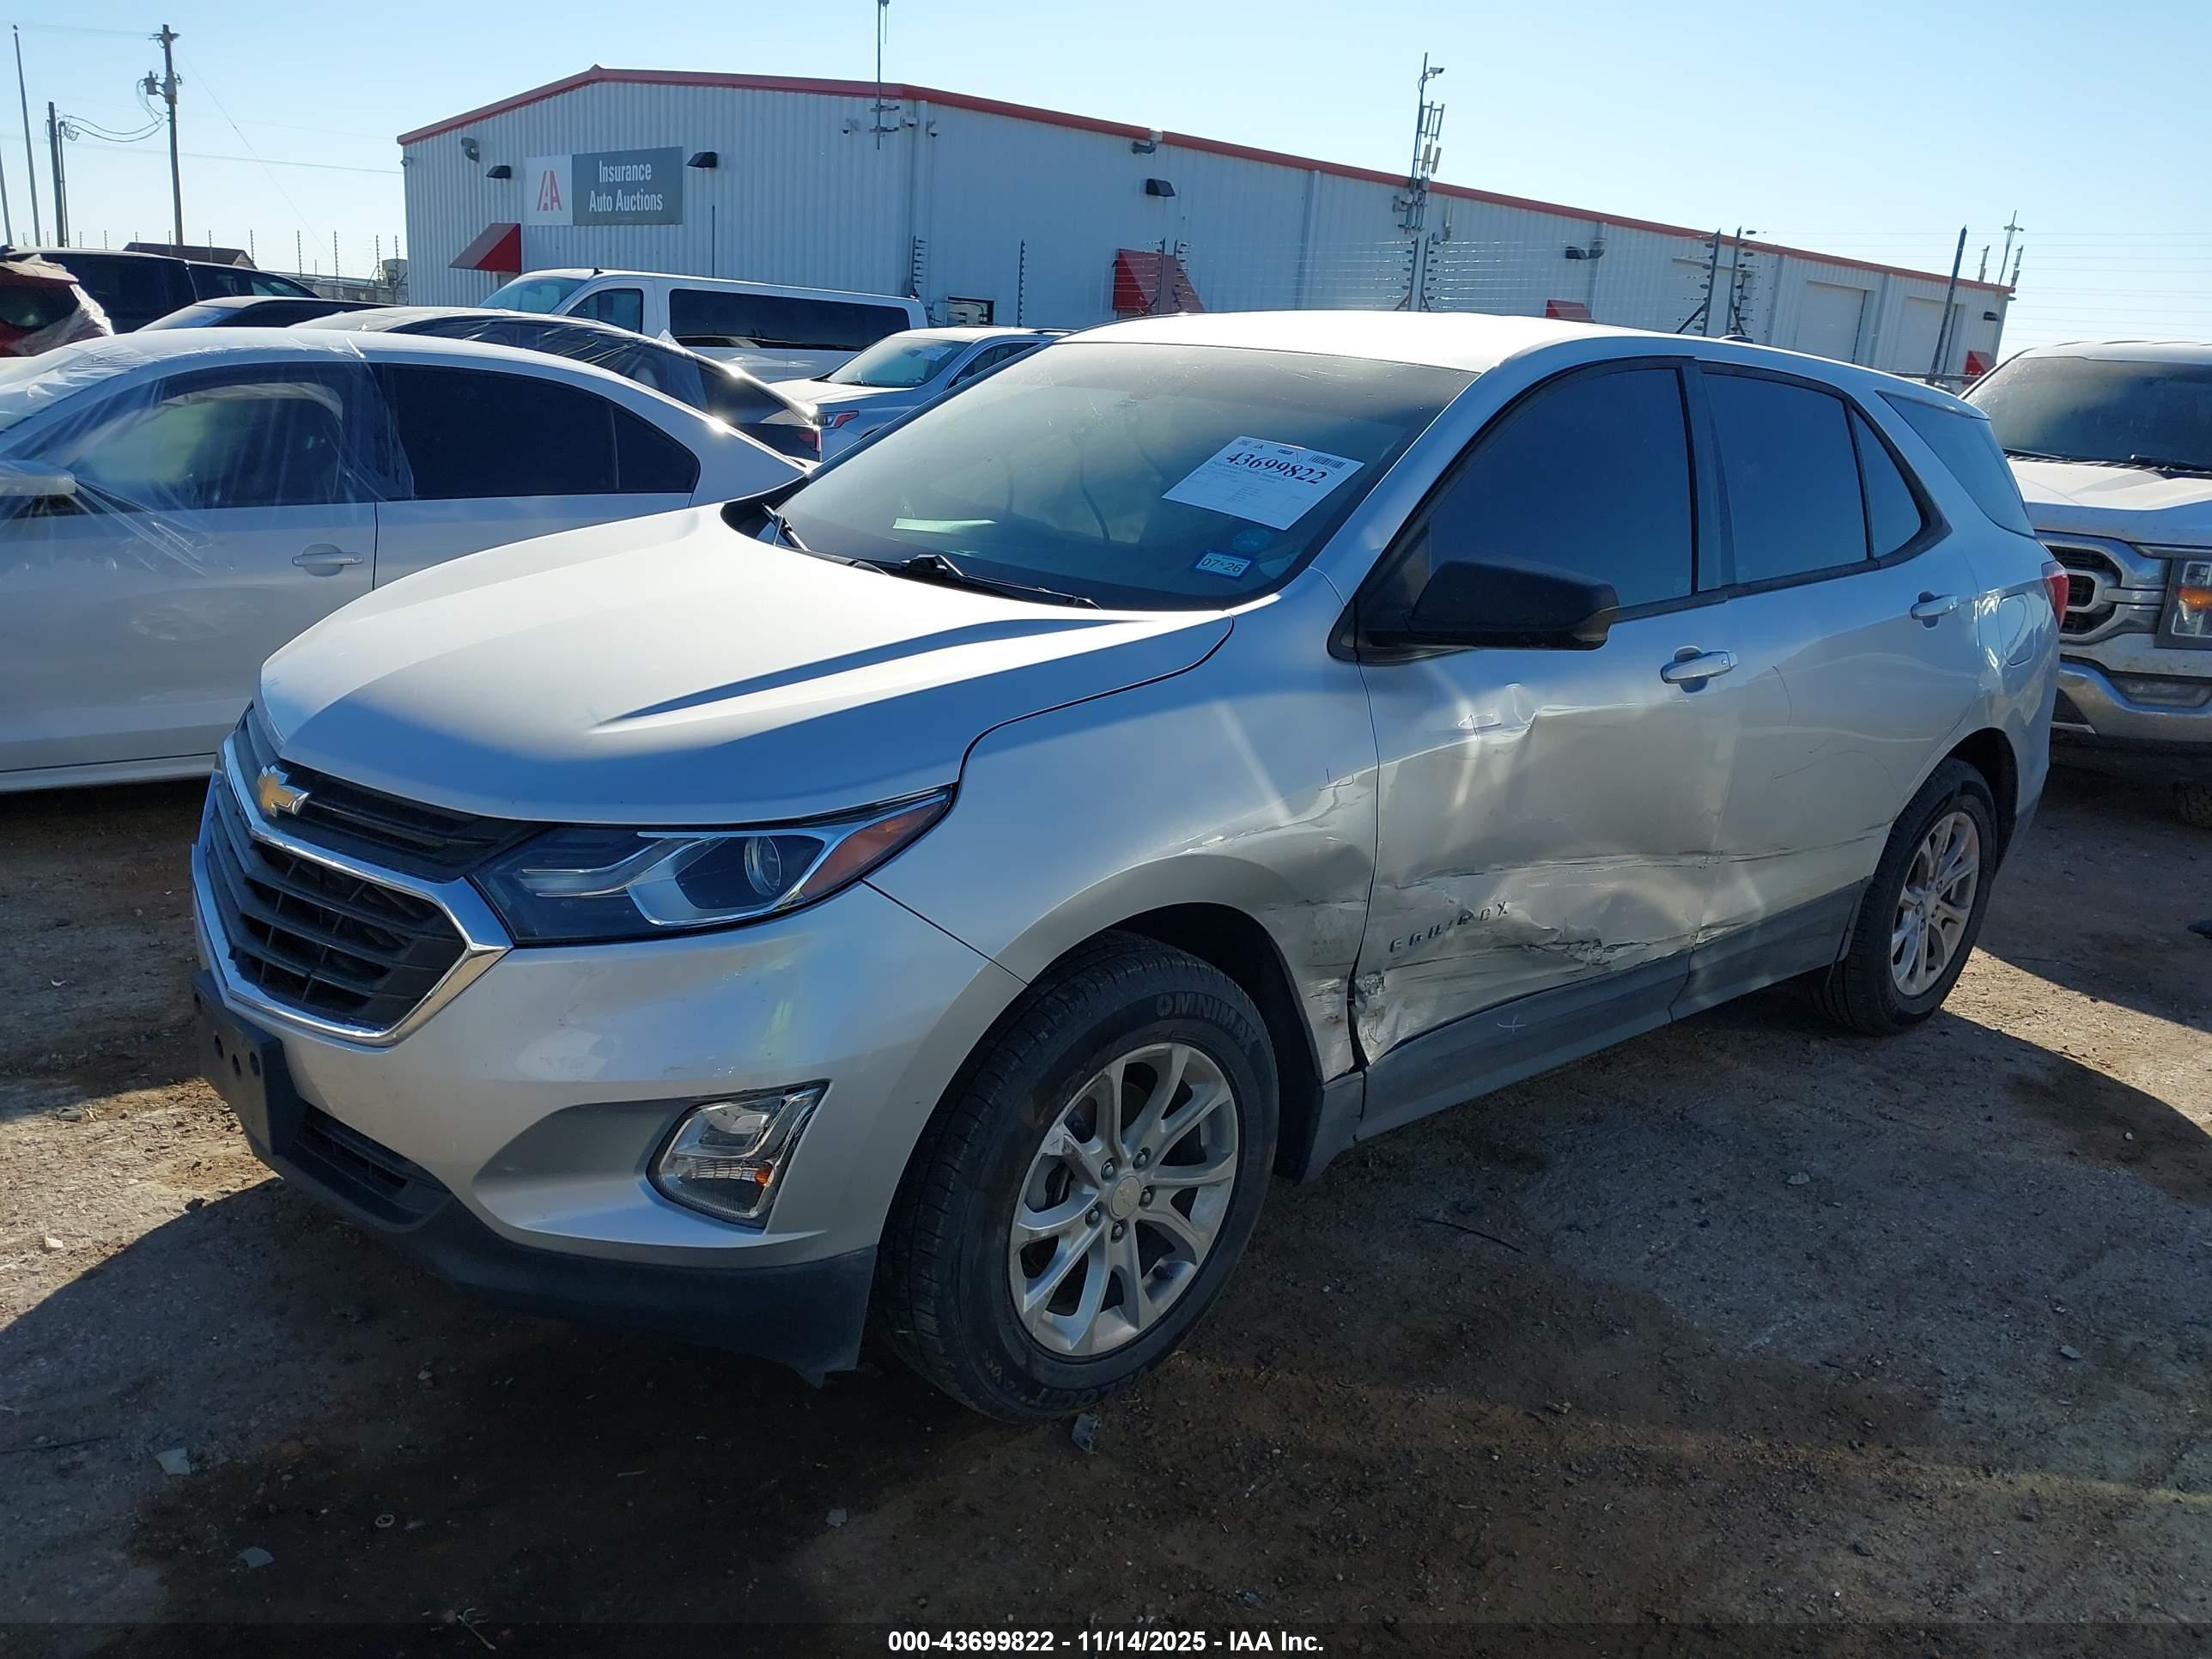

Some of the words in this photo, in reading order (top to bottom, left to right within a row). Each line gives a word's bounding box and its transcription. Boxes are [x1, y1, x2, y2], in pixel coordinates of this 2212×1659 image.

[599, 160, 652, 183] Insurance
[589, 190, 613, 213] Auto
[615, 188, 663, 212] Auctions
[1226, 452, 1328, 485] 43699822
[1201, 557, 1221, 568] 07
[1223, 562, 1244, 573] 26
